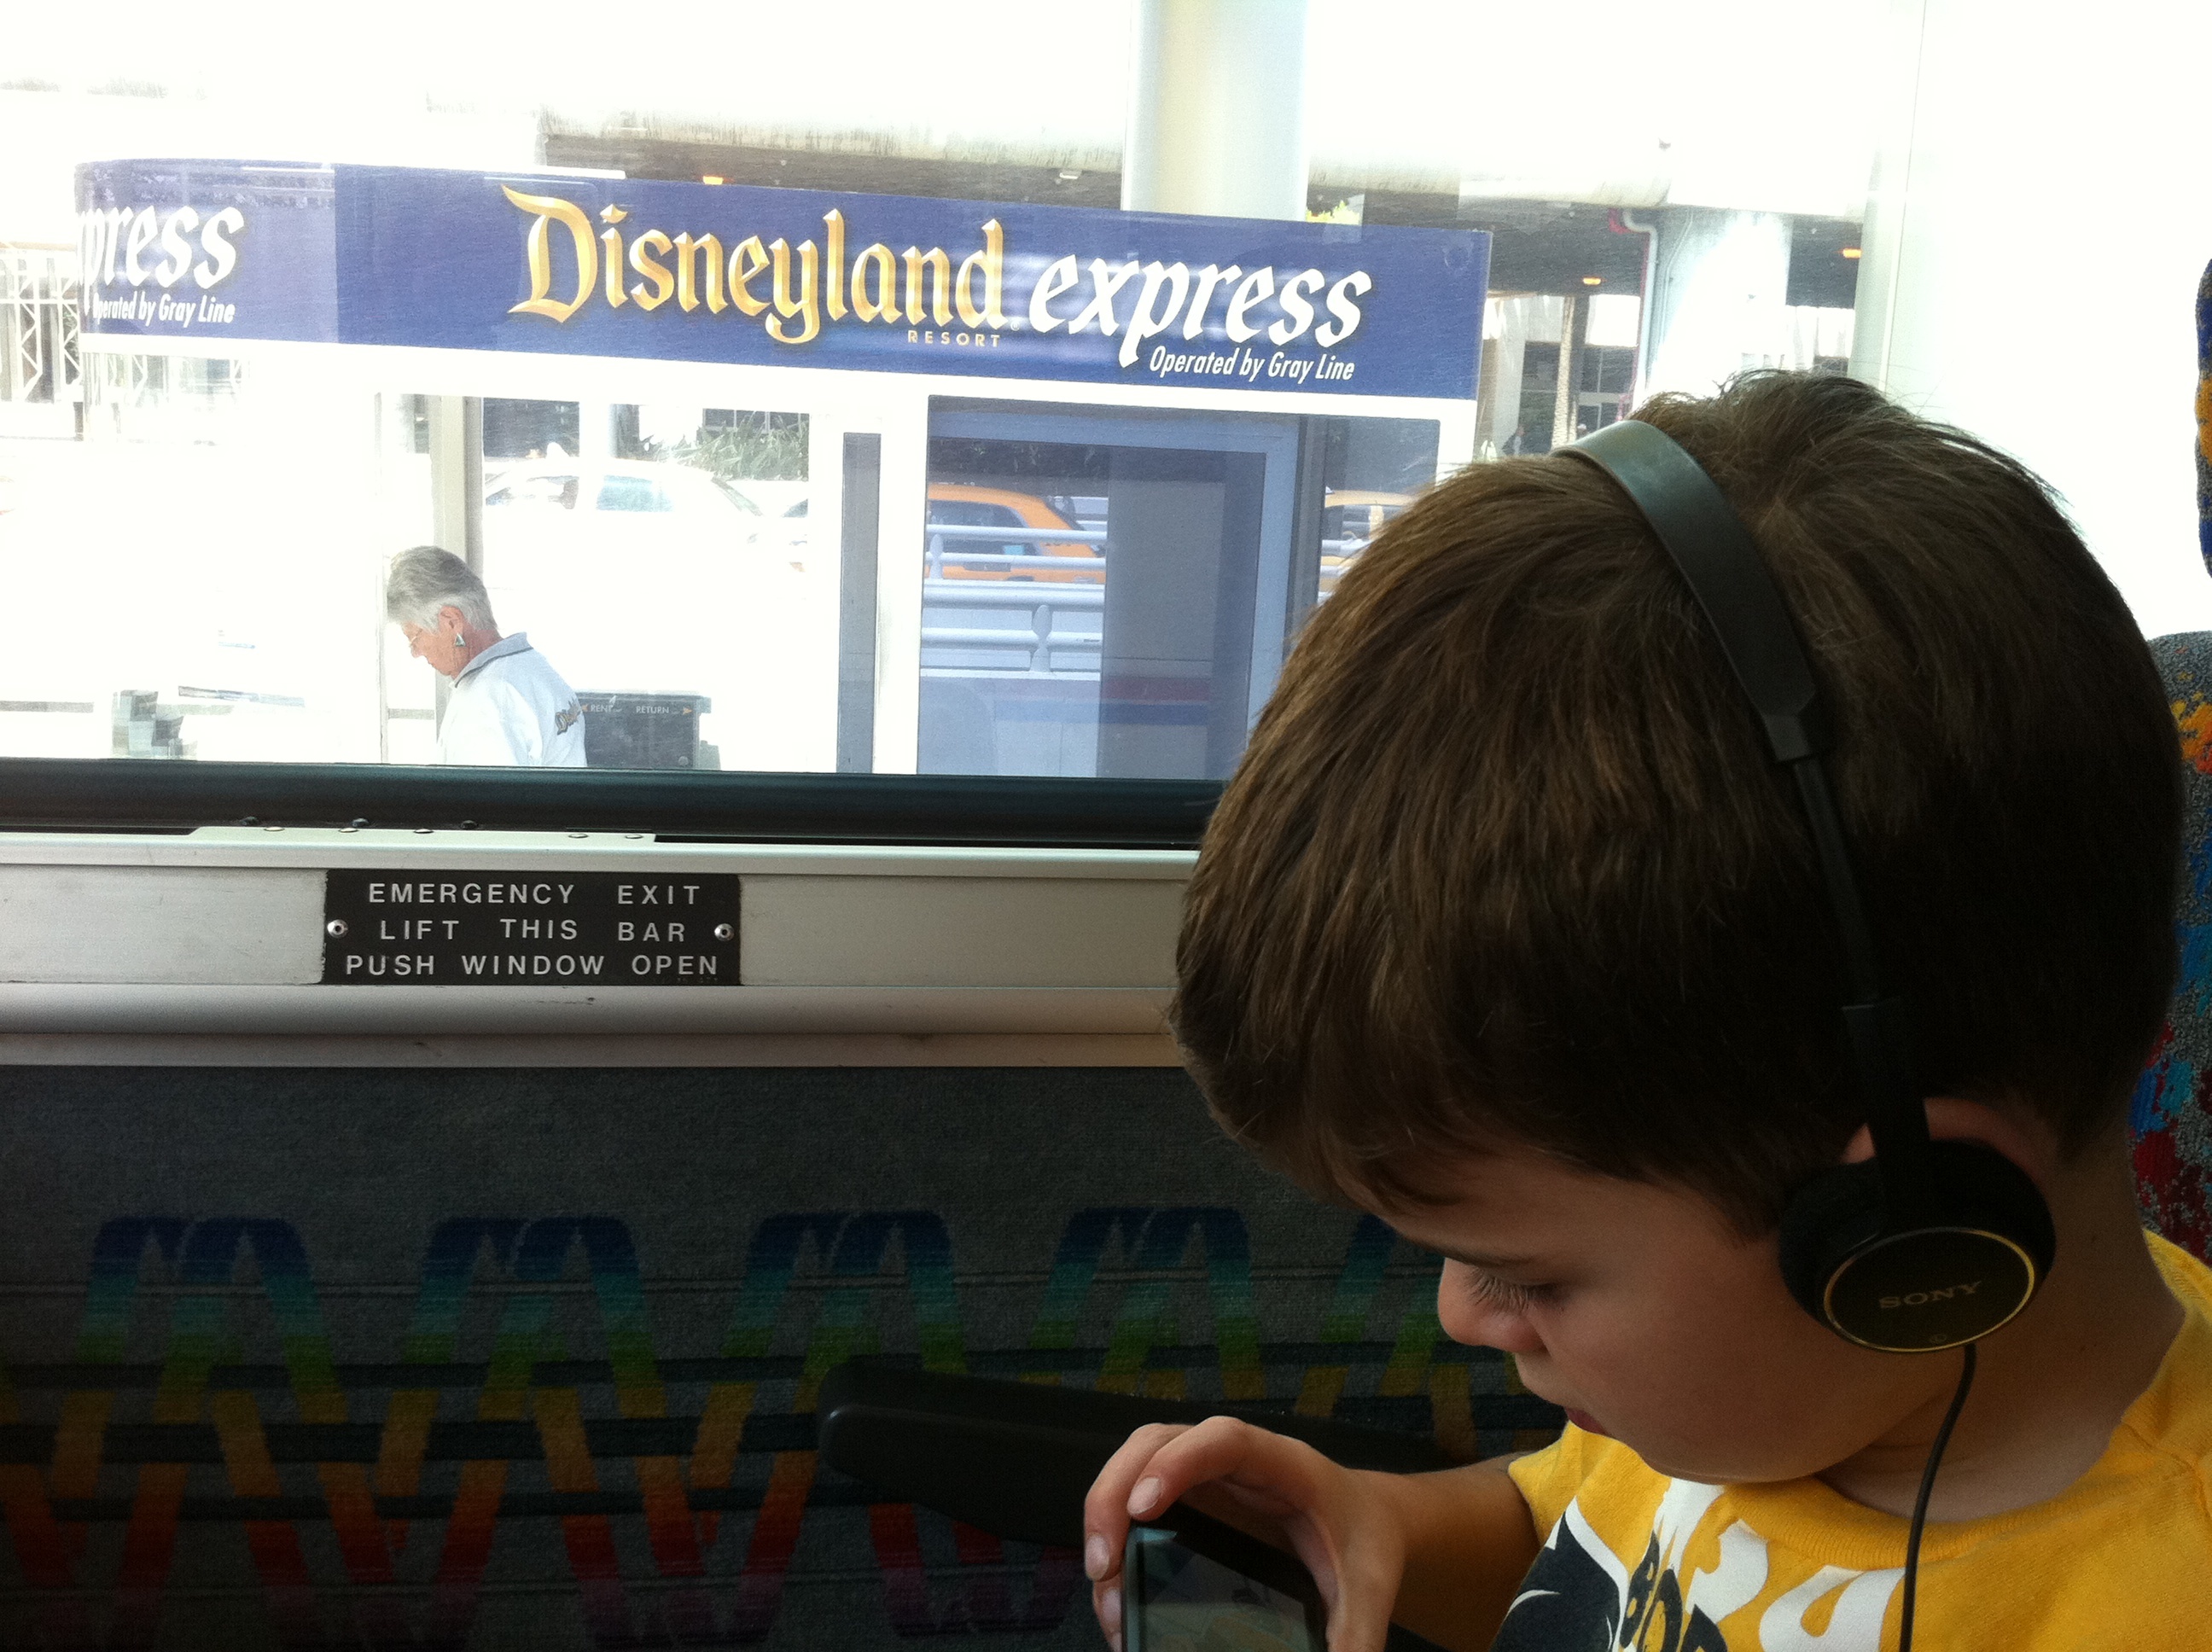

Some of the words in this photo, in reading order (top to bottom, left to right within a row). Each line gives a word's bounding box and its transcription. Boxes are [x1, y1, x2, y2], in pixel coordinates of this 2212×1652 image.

[501, 184, 1005, 344] Disneyland
[1028, 253, 1372, 369] express
[138, 291, 157, 327] by
[158, 294, 196, 328] Gray
[198, 294, 236, 323] Line
[907, 329, 1001, 348] RESORT
[1150, 345, 1240, 378] Operated
[1239, 348, 1266, 382] by
[1267, 352, 1314, 384] Gray
[1315, 354, 1355, 381] Line
[635, 706, 669, 714] RETURN
[369, 882, 574, 904] EMERGENCY
[617, 885, 701, 905] EXIT
[380, 920, 460, 940] LIFT
[499, 918, 578, 939] THIS
[618, 922, 685, 942] BAR
[346, 955, 435, 976] PUSH
[461, 955, 605, 975] WINDOW
[631, 956, 718, 975] OPEN
[1877, 1281, 1982, 1309] SONY
